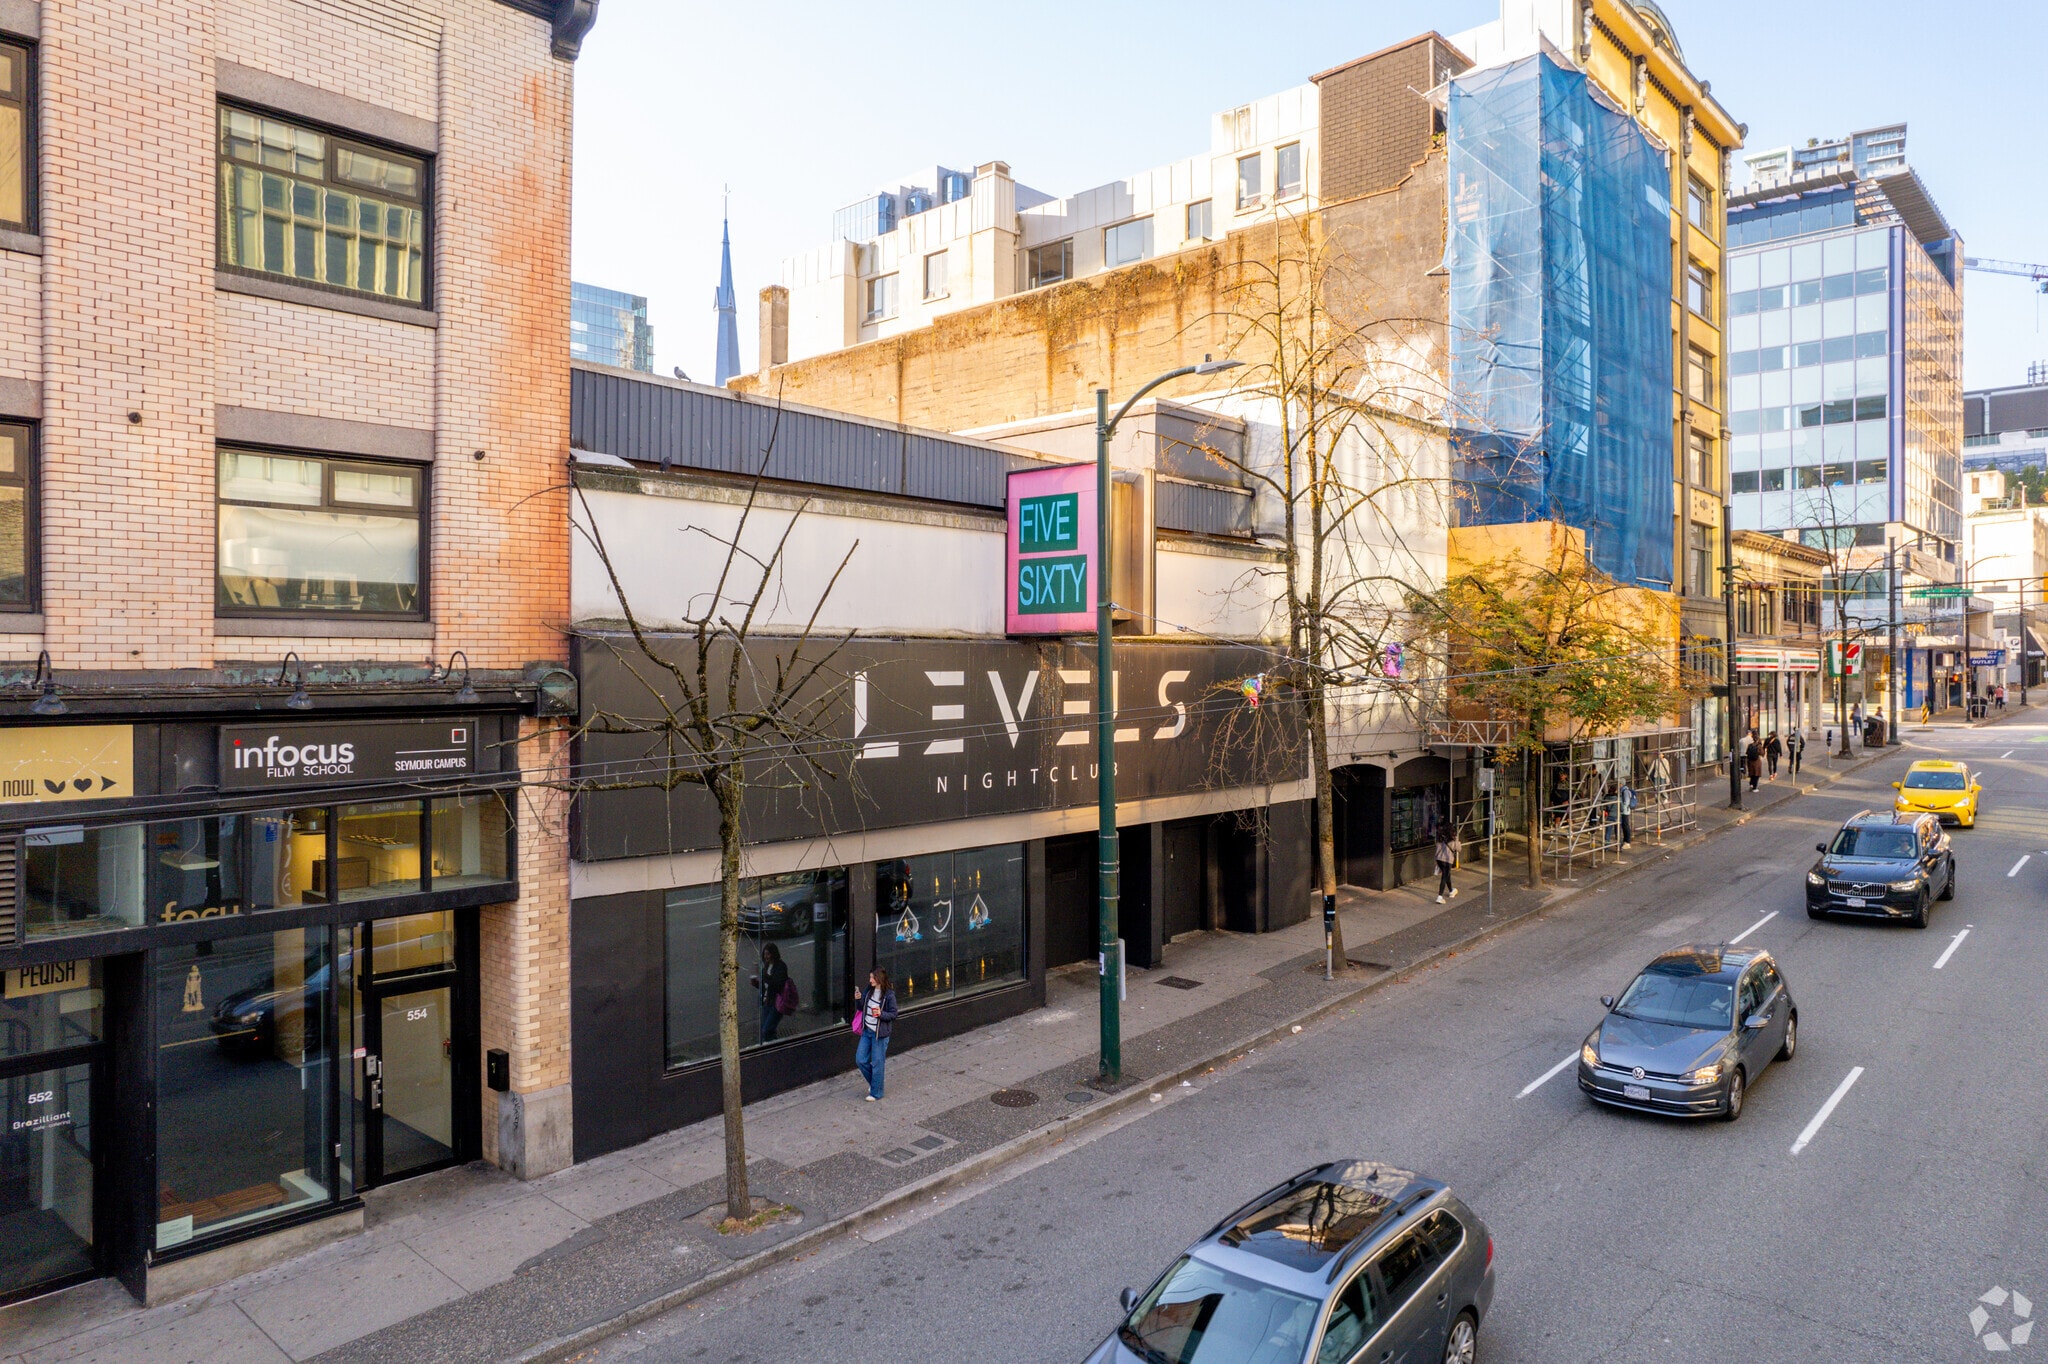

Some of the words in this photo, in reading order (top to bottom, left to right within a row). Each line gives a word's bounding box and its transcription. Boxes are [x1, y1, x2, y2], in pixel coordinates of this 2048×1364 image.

[1020, 500, 1071, 544] FIVE
[1020, 562, 1086, 606] SIXTY
[854, 670, 1191, 759] LEVELS
[233, 735, 355, 769] infocus
[267, 766, 295, 778] FILM
[303, 764, 354, 776] SCHOOL
[394, 758, 433, 772] SEYMOUR
[433, 757, 467, 769] CAMPUS
[20, 960, 76, 989] PEQISH
[407, 1008, 428, 1021] 554
[28, 1090, 53, 1104] 552
[12, 1110, 71, 1130] Brazilliant
